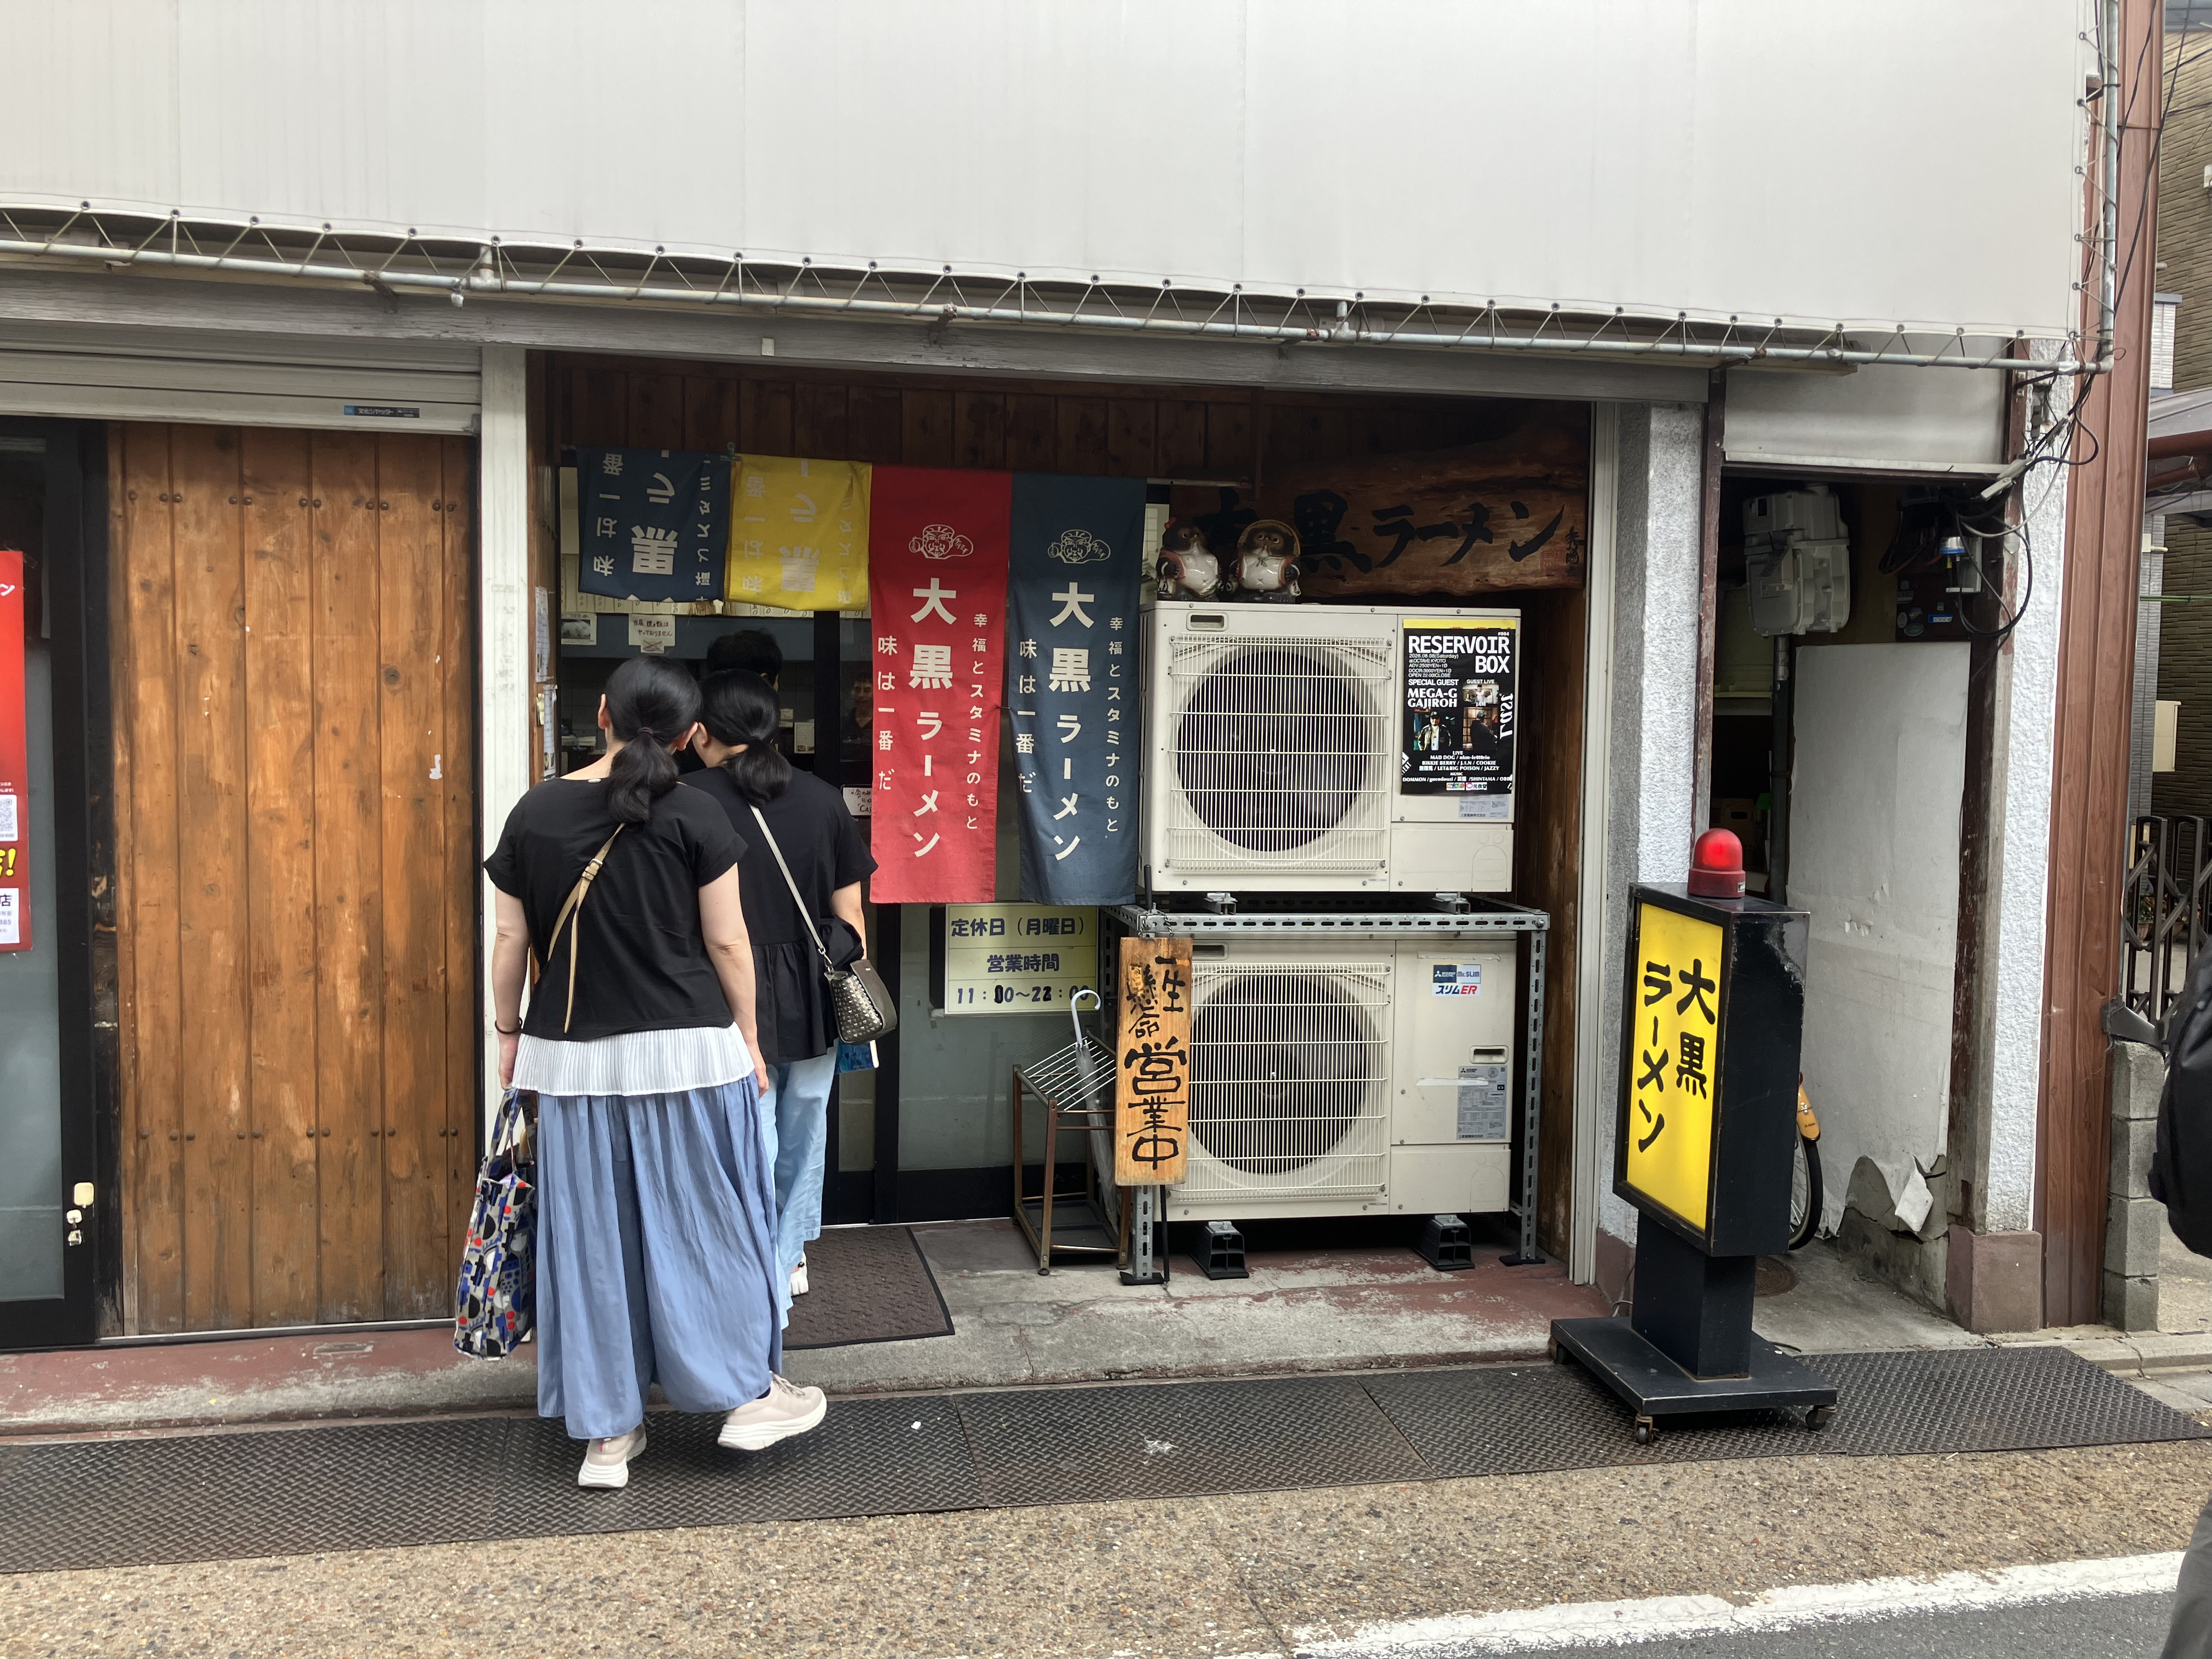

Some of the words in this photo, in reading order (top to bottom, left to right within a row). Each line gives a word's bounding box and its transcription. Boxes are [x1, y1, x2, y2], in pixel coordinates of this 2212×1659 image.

[878, 635, 898, 791] 味は一番だ
[1407, 688, 1457, 698] MEGA-G
[1407, 698, 1457, 709] GAJIROH
[1408, 635, 1510, 654] RESERVOIR
[1475, 656, 1510, 673] BOX
[909, 578, 958, 858] 大黒ラーメン
[966, 613, 988, 830] 幸福とスタミナのもと
[1016, 639, 1038, 793] 味は一番だ
[1048, 582, 1095, 861] 大黒ラーメン
[1106, 617, 1124, 833] 幸福とスタミナのもと
[951, 917, 1085, 936] 定休日（月曜日）
[987, 953, 1060, 973] 営業時間
[1435, 985, 1478, 995] スリムER
[1637, 960, 1673, 1153] ラーメン
[1677, 958, 1716, 1100] 大黒
[1124, 1036, 1187, 1170] 営業中
